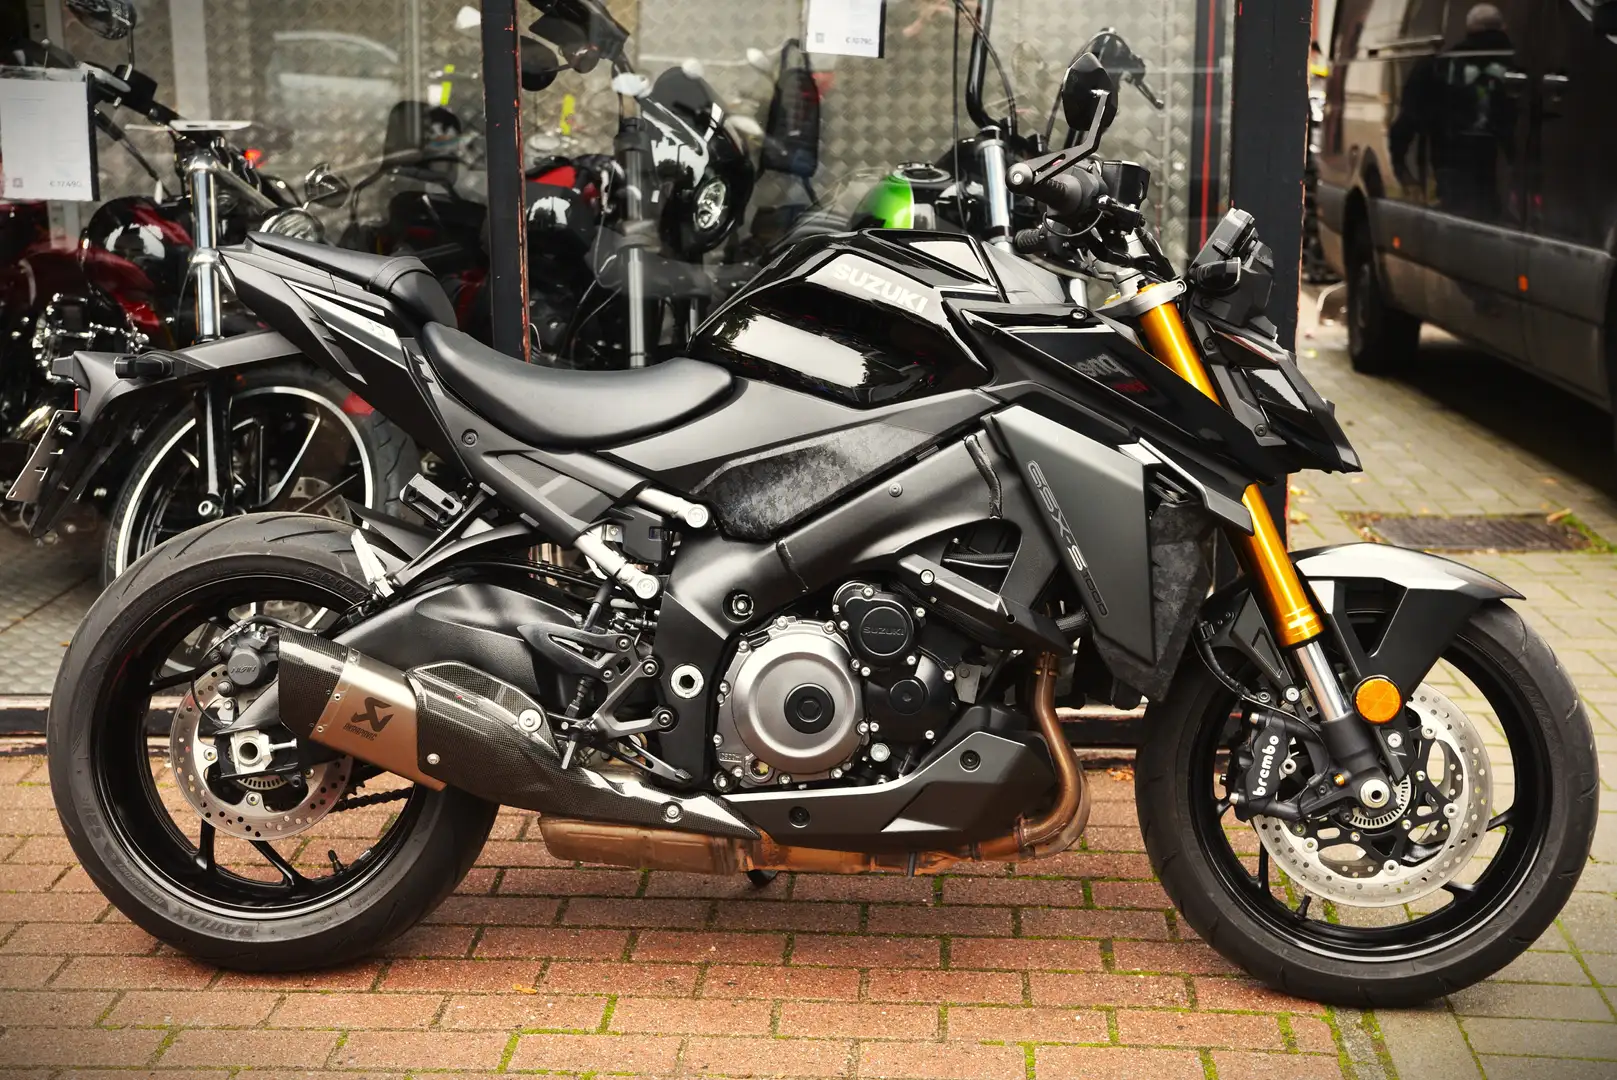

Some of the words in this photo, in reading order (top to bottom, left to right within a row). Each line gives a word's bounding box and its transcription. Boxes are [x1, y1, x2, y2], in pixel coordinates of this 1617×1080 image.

[832, 263, 929, 314] SUZUKI
[863, 626, 905, 636] SUZUKI
[1252, 735, 1279, 796] brembo
